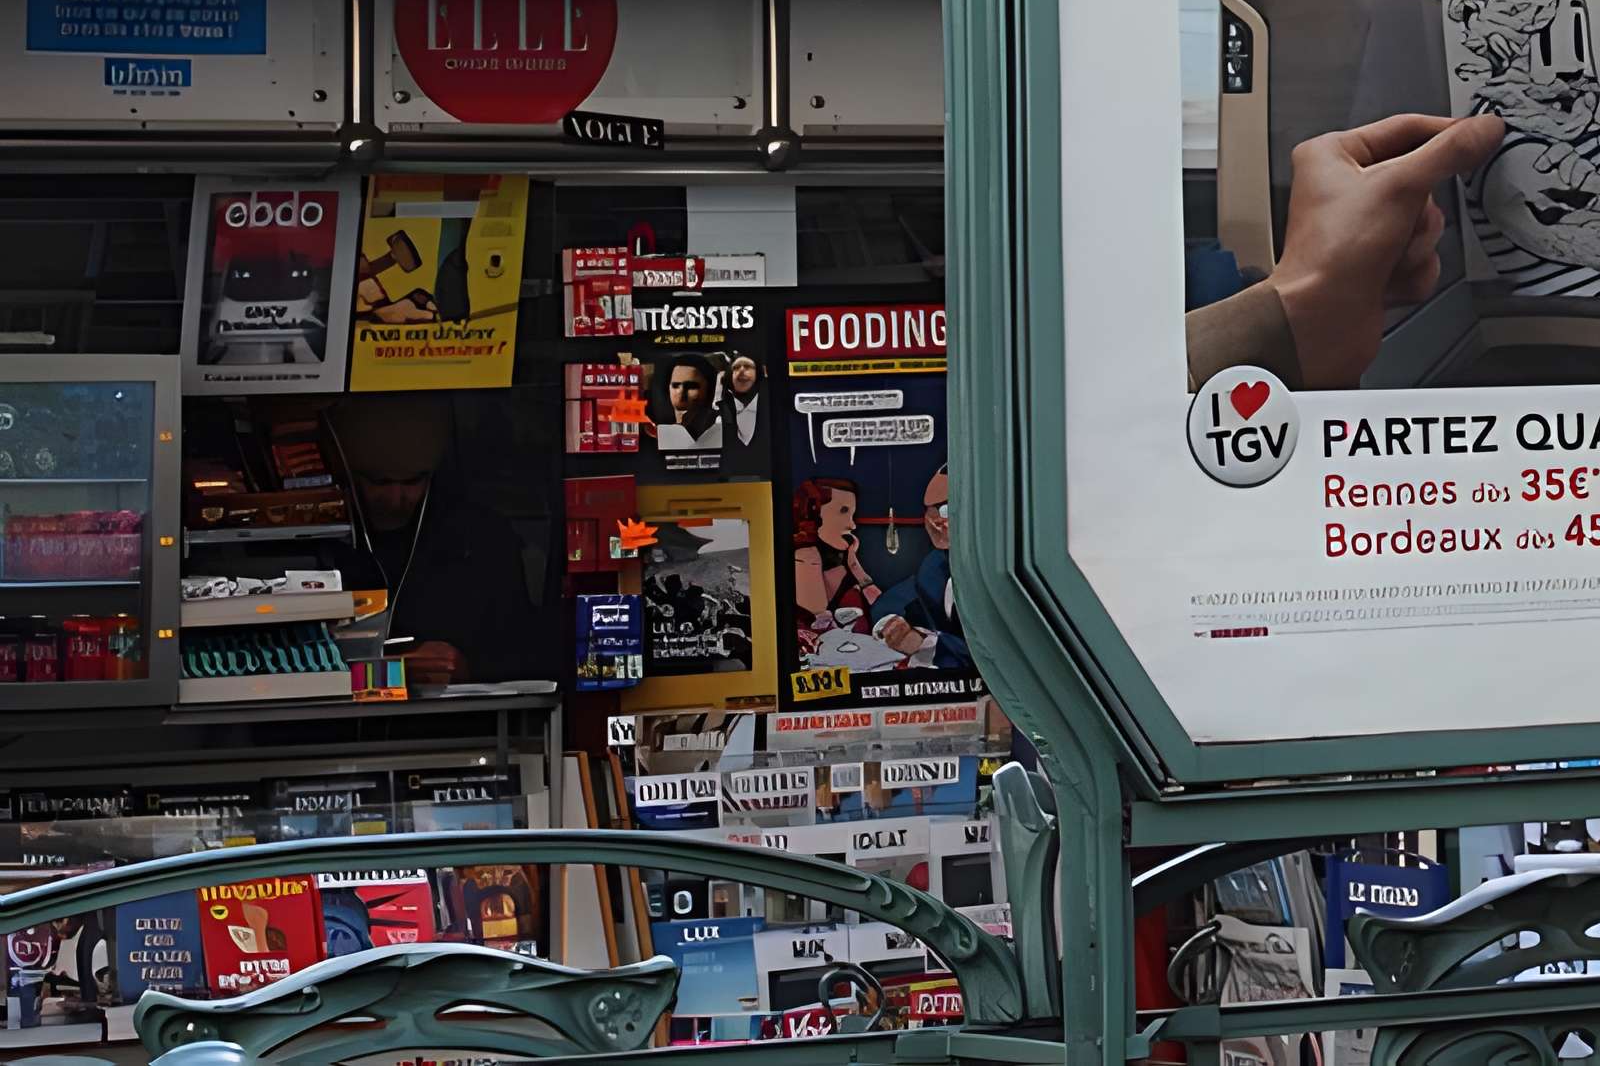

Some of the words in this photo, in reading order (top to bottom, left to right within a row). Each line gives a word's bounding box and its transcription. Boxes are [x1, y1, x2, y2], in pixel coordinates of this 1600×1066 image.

[792, 310, 947, 352] FOODING
[1206, 422, 1289, 467] TGV
[1323, 415, 1498, 458] PARTEZ
[1324, 474, 1458, 508] Rennes
[1325, 519, 1502, 557] Bordeaux
